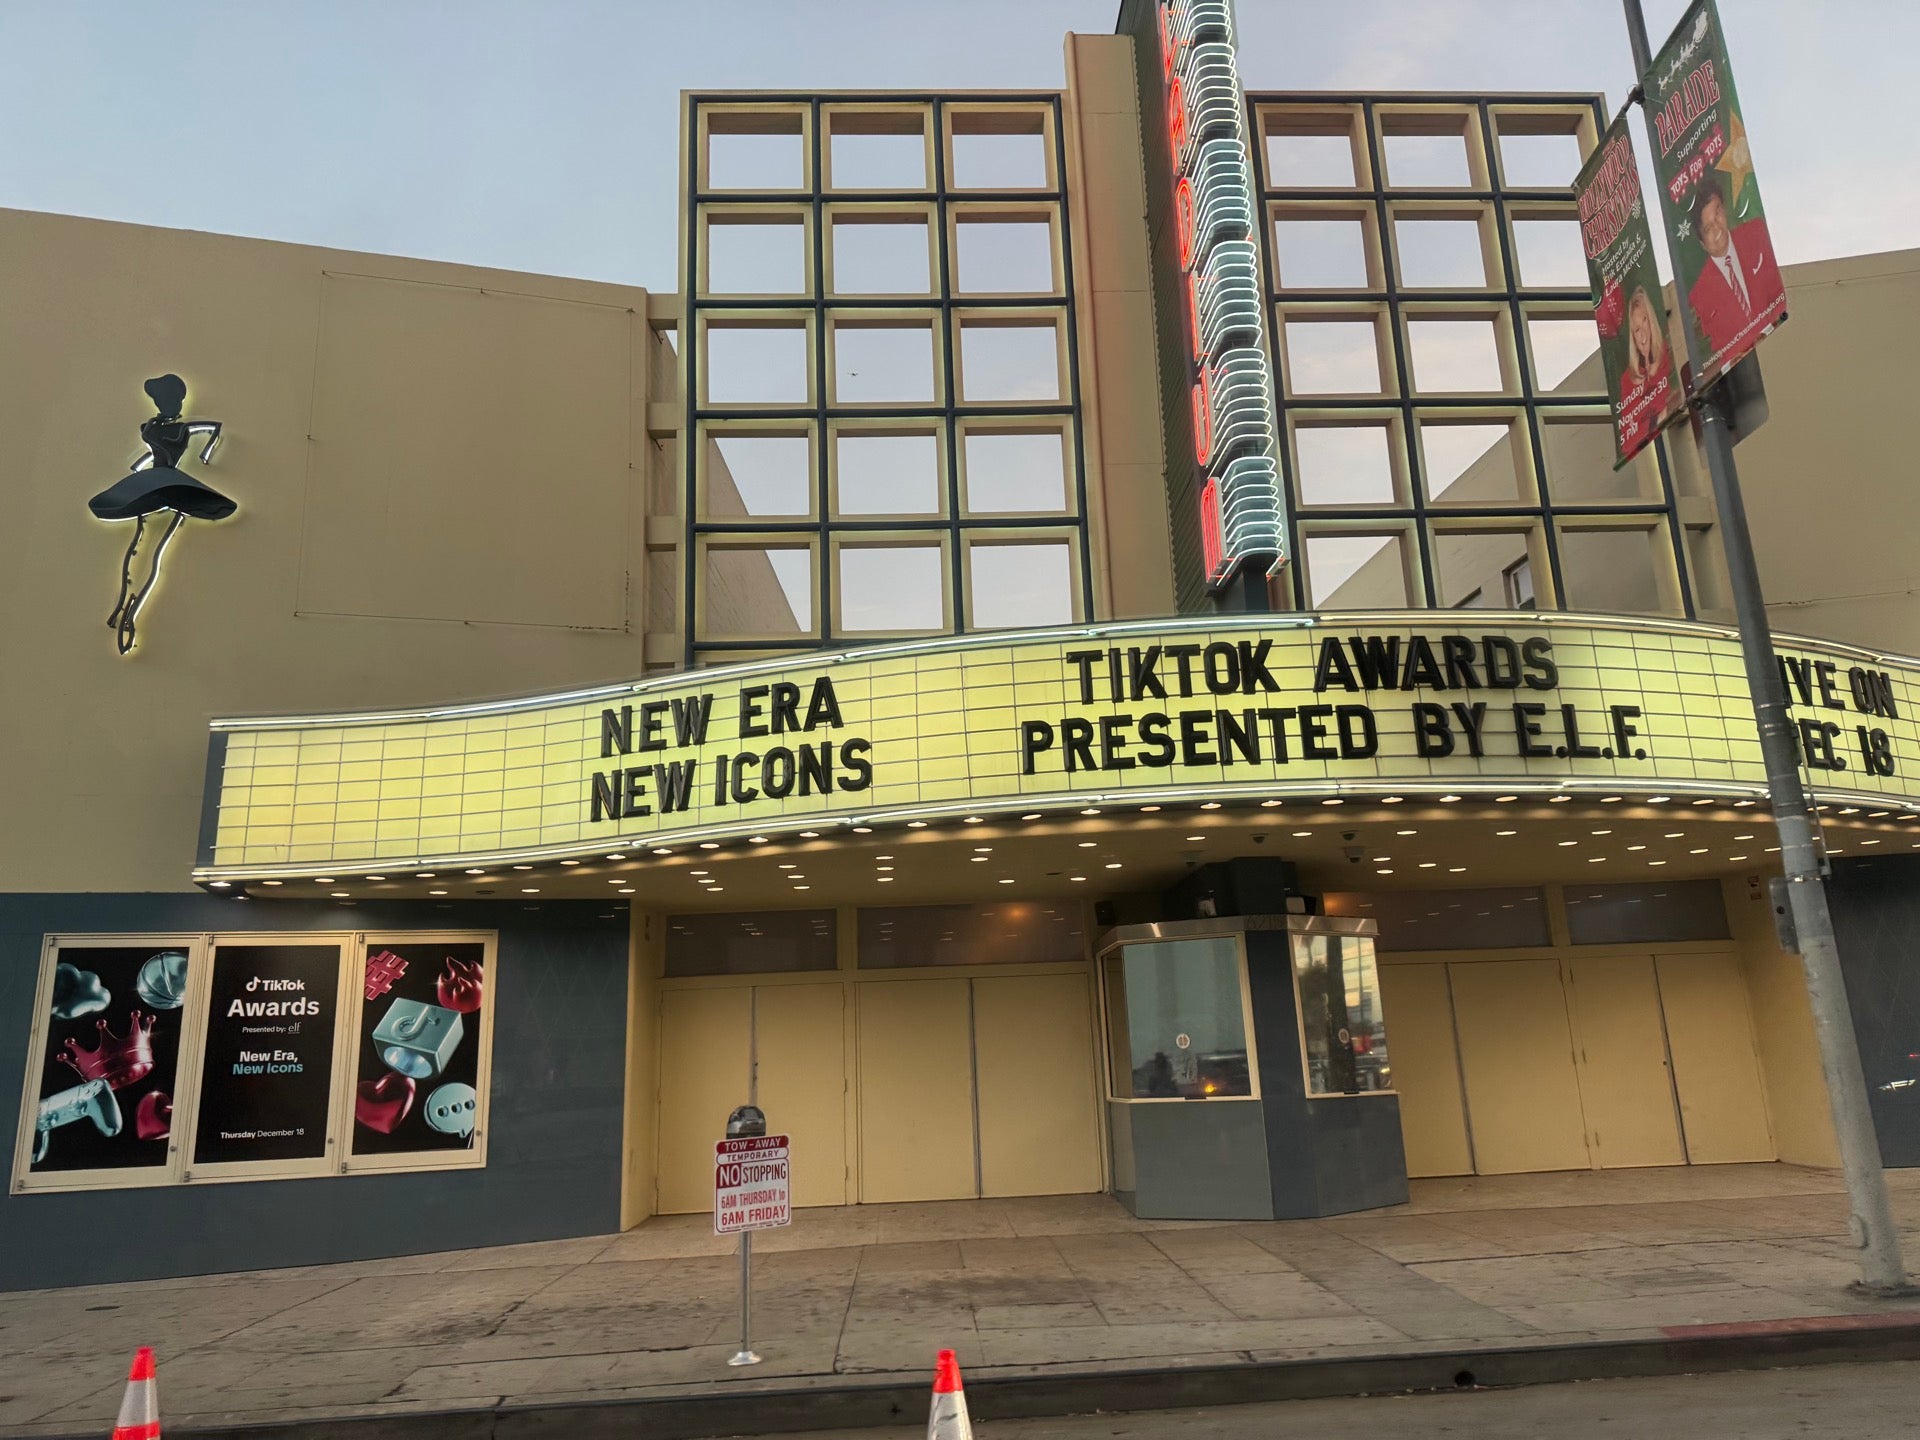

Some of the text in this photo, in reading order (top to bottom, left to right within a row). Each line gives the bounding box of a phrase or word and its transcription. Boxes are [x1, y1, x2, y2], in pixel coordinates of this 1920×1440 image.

[1654, 60, 1720, 159] PARADE
[1677, 109, 1716, 162] Supporting
[1670, 134, 1723, 195] TOYS FOR TOTS
[1582, 153, 1640, 260] CHRISTMAS
[1602, 236, 1629, 275] Hosted by
[1605, 274, 1623, 297] Laura
[1616, 382, 1644, 413] Sunday
[1618, 376, 1668, 430] November 30
[1620, 421, 1639, 446] 5 PM
[1066, 635, 1560, 706] TIKTOK AWARDS
[1776, 655, 1899, 719] IVE ON
[600, 676, 844, 759] NEW ERA
[1020, 702, 1648, 775] PRESENTED BY E.L.F.
[1788, 717, 1895, 777] EC 18
[590, 737, 872, 823] NEW ICONS
[262, 979, 306, 991] TikTok
[227, 997, 320, 1017] Awards
[242, 1025, 275, 1033] Presented
[276, 1025, 286, 1034] by:
[232, 1062, 304, 1075] New Icons
[240, 1050, 299, 1063] New Era,
[220, 1127, 305, 1139] Thursday December 18
[725, 1137, 781, 1152] TOW-AWAY
[727, 1149, 780, 1162] TEMPORARY
[720, 1163, 787, 1186] NO STOPPING
[739, 1189, 777, 1206] THURSDAY
[779, 1188, 786, 1200] to
[721, 1209, 745, 1226] 6AM
[748, 1205, 786, 1222] FRIDAY
